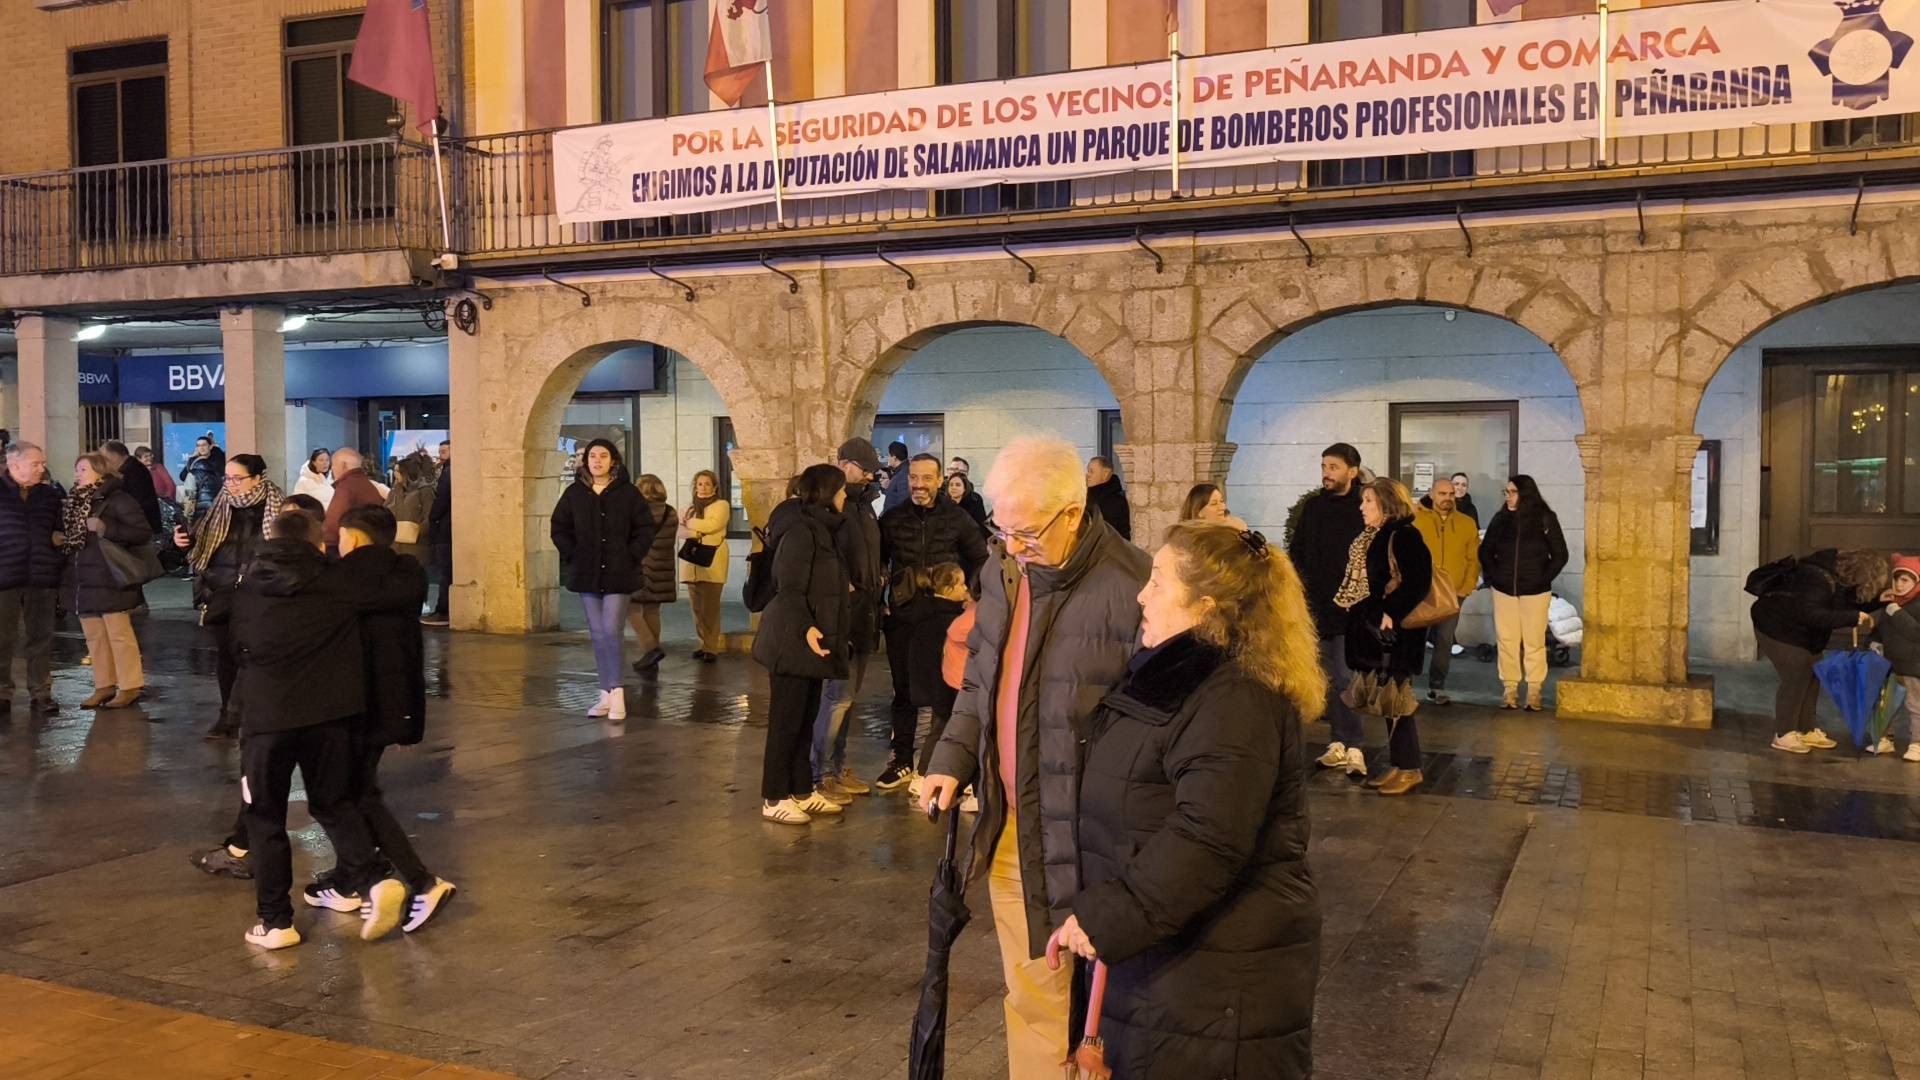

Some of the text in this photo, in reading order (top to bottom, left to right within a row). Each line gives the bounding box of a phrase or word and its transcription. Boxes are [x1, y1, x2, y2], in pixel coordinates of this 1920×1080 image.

[632, 165, 717, 203] EXIGIMOS
[720, 164, 733, 194] A
[737, 161, 757, 193] LA
[884, 146, 909, 179] DE
[913, 133, 1041, 177] SALAMANCA
[1047, 129, 1077, 165] UN
[1083, 121, 1170, 162] PARQUE
[1178, 117, 1205, 153] DE
[1210, 103, 1349, 150] BOMBEROS
[1355, 83, 1565, 138] PROFESIONALES
[1615, 64, 1792, 118] PEÑARANDA
[672, 25, 1721, 156] POR LA SEGURIDAD DE LOS VECINOS DE PEÑARANDA Y COMARCA
[78, 372, 111, 385] BBVA
